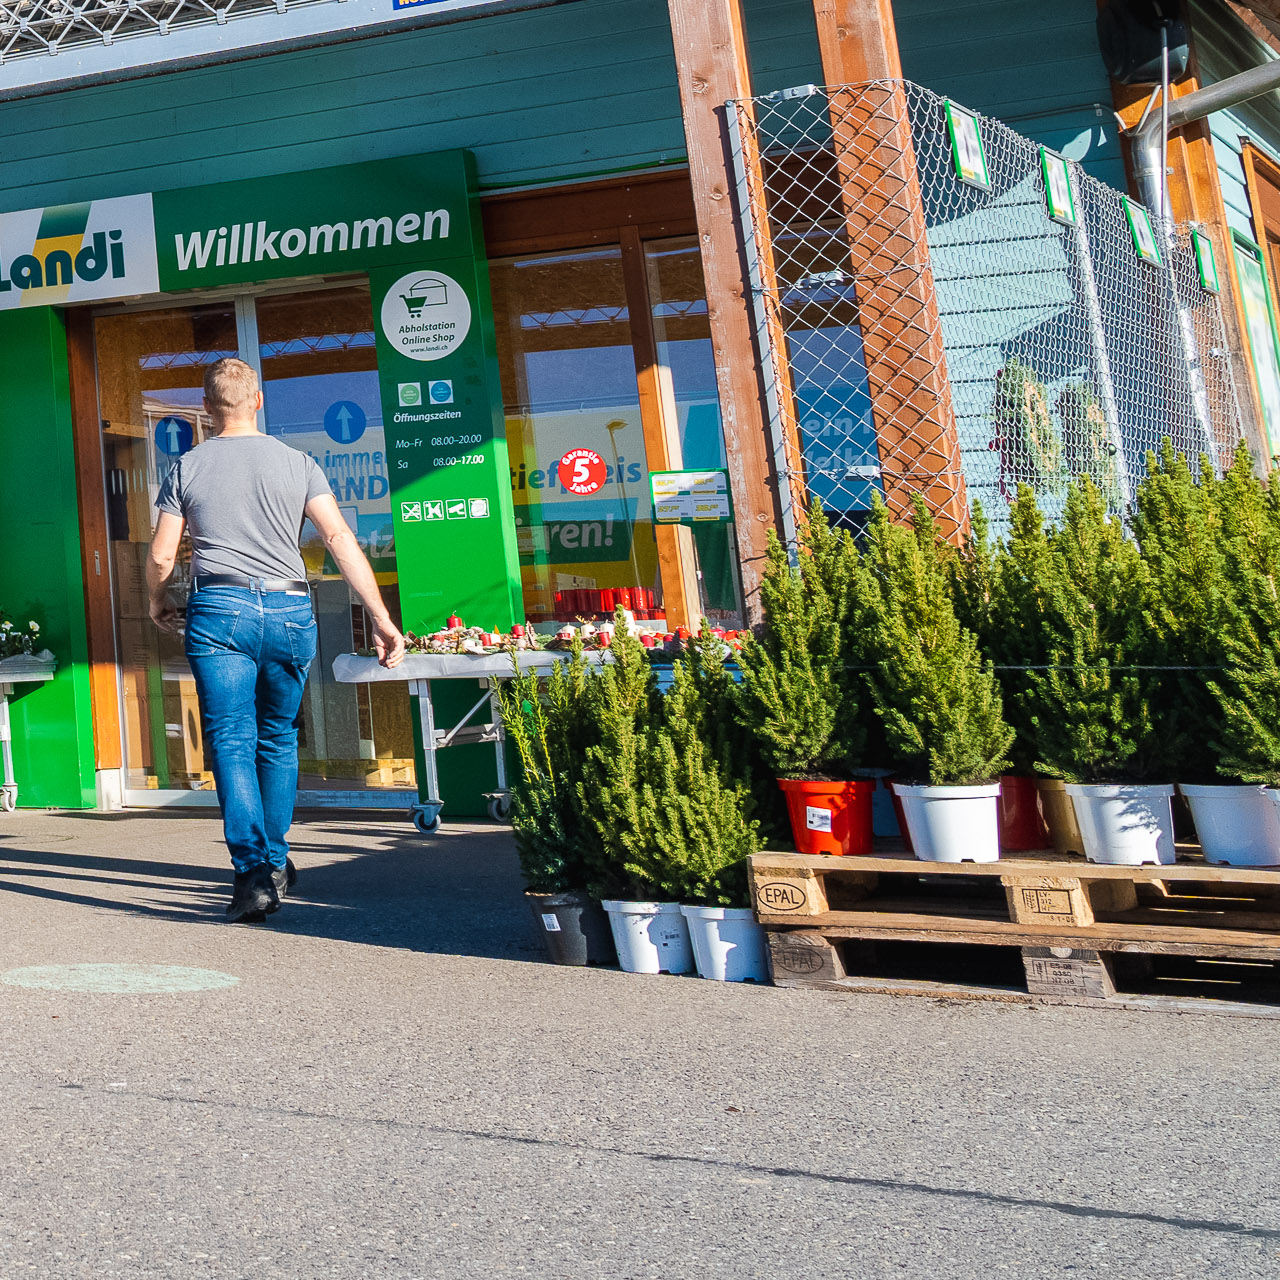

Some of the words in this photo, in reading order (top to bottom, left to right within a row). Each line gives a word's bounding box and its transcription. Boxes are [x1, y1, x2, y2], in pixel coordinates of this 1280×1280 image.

[174, 208, 450, 271] Willkommen
[398, 321, 456, 334] Abholstation
[401, 335, 431, 345] Online
[432, 333, 455, 342] Shop
[410, 344, 448, 353] www.landi.ch
[393, 410, 461, 423] Öffnungszeiten
[397, 459, 409, 469] Sa
[561, 450, 600, 466] Garantie
[572, 458, 590, 483] 5
[569, 481, 599, 493] Jahre
[765, 888, 800, 905] EPAL
